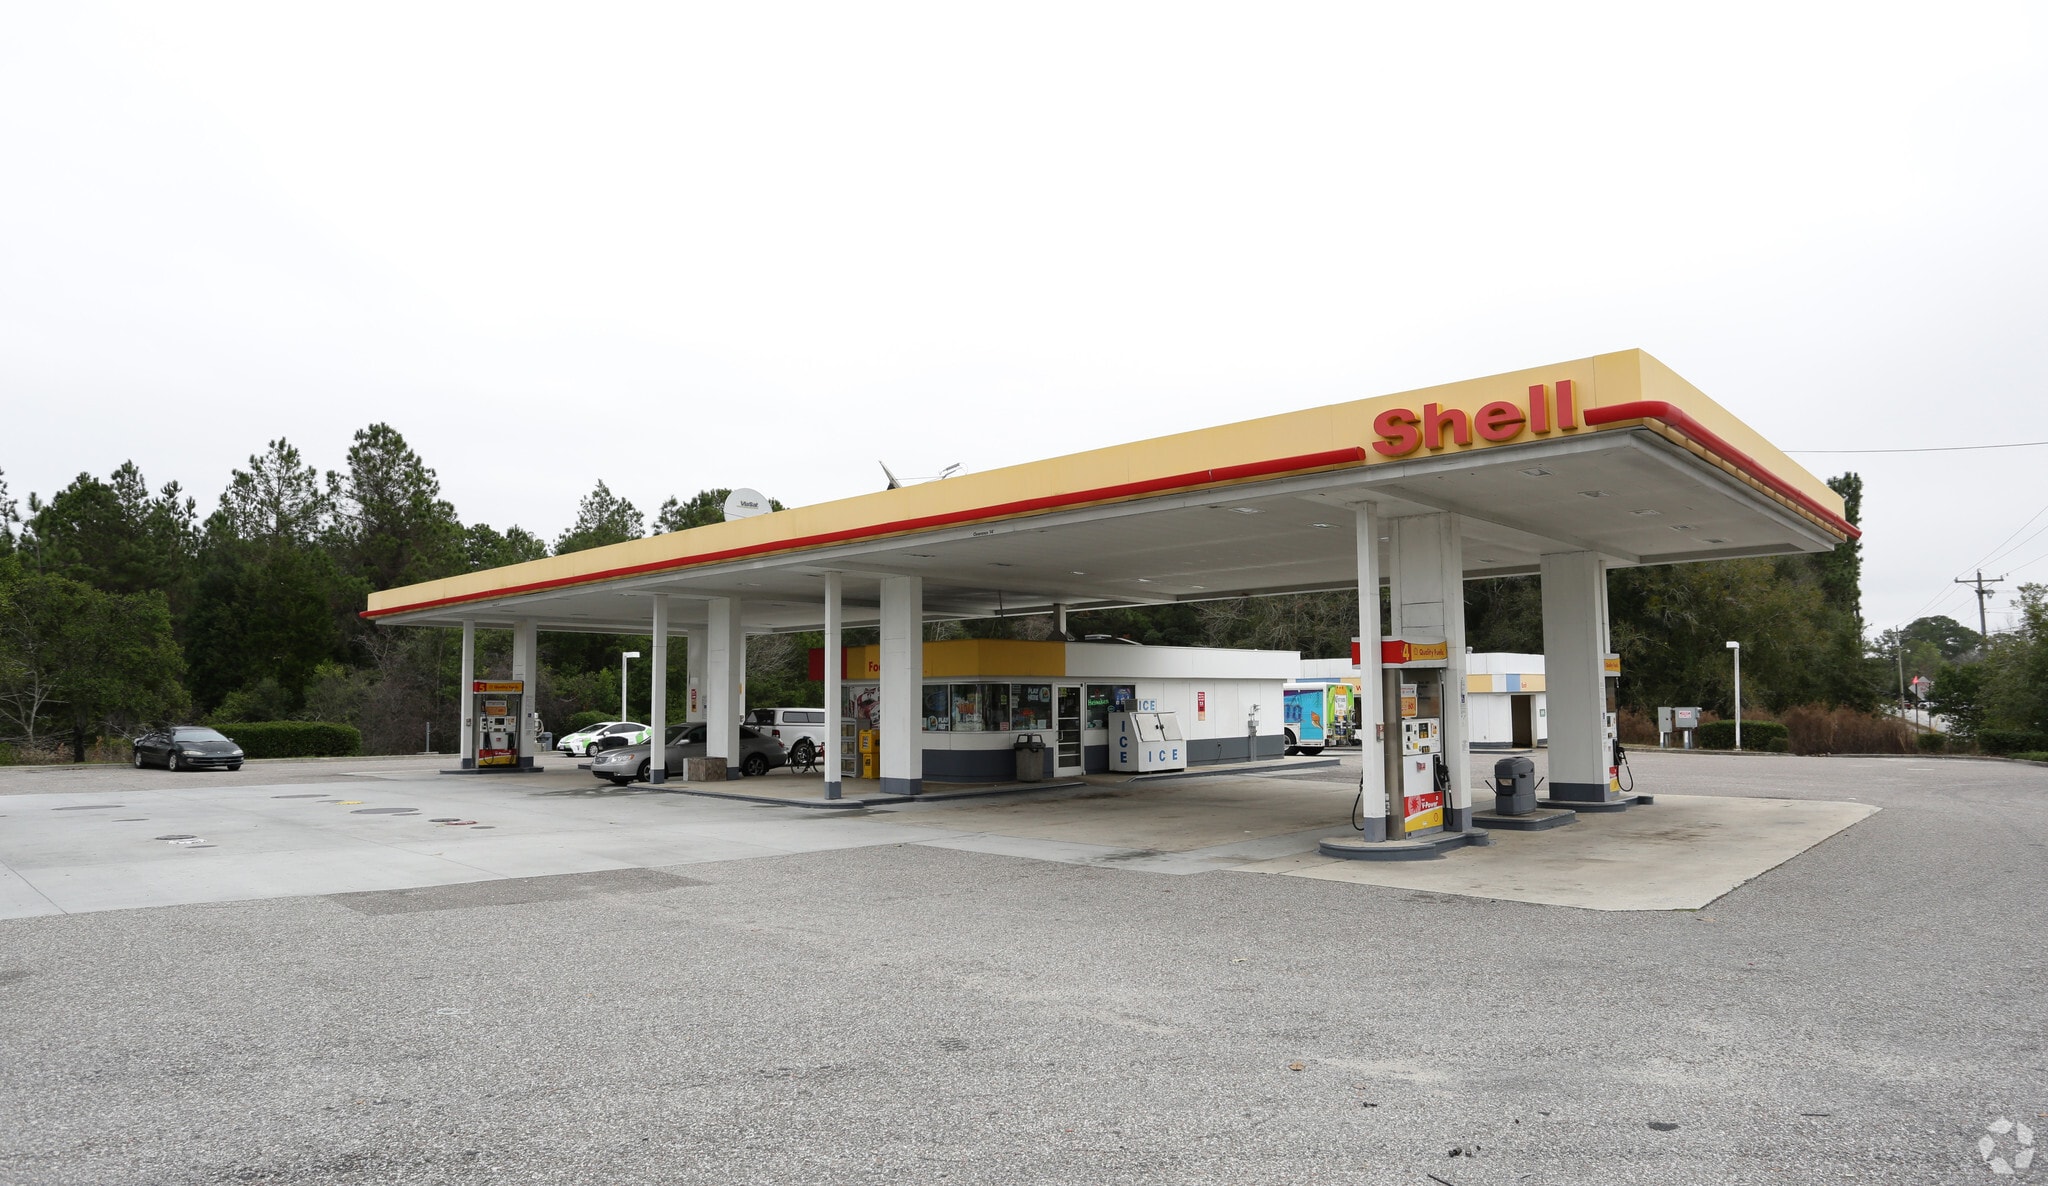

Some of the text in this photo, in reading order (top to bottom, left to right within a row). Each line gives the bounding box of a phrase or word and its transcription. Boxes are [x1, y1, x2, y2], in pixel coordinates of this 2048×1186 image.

[1402, 643, 1410, 660] 4
[1419, 647, 1434, 657] Quality
[868, 661, 880, 672] Fo
[1138, 700, 1155, 711] ICE
[1120, 721, 1128, 763] ICE
[1148, 749, 1178, 762] ICE
